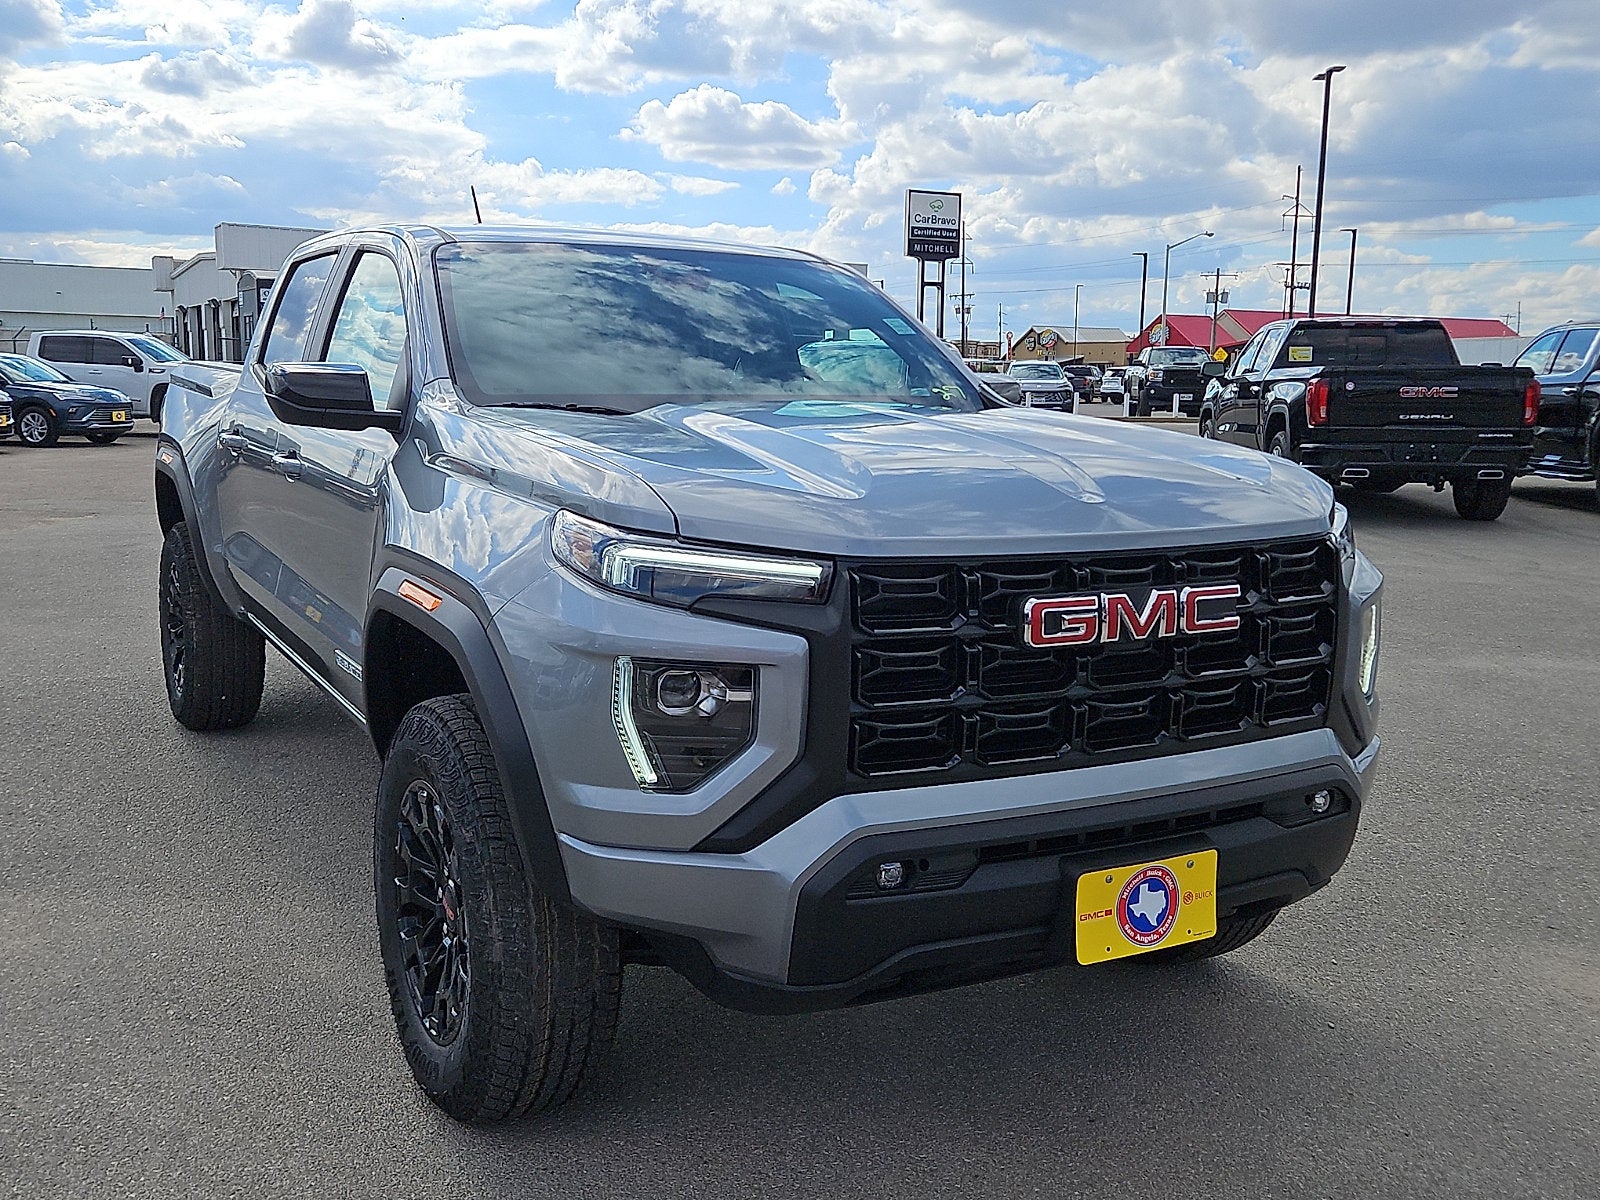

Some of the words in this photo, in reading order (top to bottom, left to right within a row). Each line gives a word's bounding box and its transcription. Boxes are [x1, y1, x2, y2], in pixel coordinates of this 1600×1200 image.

[914, 213, 957, 225] CarBravo
[914, 228, 941, 236] Certified
[914, 244, 954, 253] MITCHELL
[1400, 386, 1458, 397] GMC
[1024, 584, 1241, 648] GMC
[1195, 891, 1213, 900] BUICK
[1080, 910, 1104, 922] GMC
[1123, 924, 1135, 938] San
[1159, 915, 1173, 934] Texas
